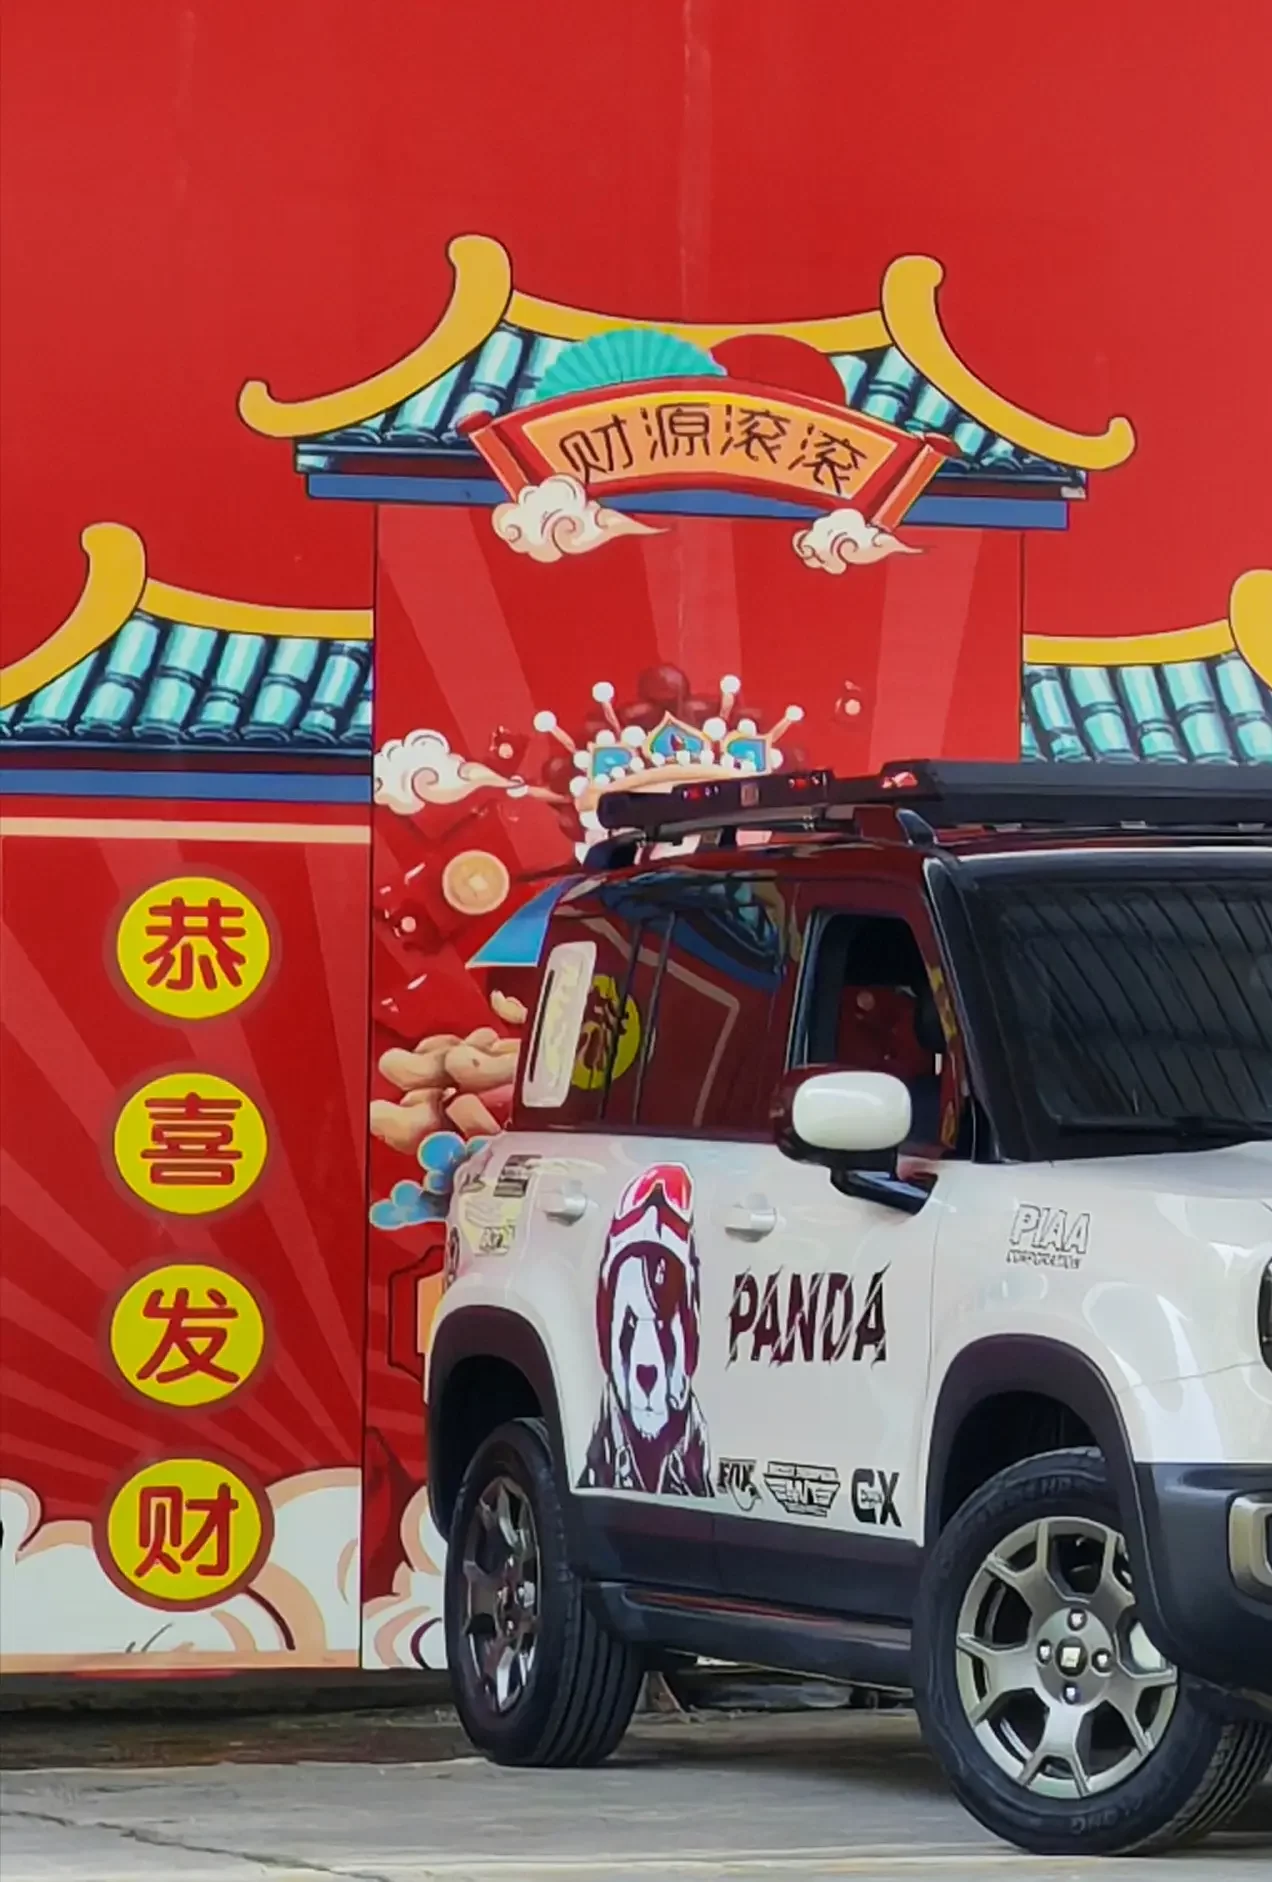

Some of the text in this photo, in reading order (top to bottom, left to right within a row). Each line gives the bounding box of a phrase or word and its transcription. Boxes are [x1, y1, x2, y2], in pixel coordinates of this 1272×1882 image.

[558, 401, 868, 496] 财源滚滚
[135, 896, 248, 1577] 恭喜发财
[1008, 1203, 1090, 1254] PIAA
[727, 1262, 891, 1370] PANDA
